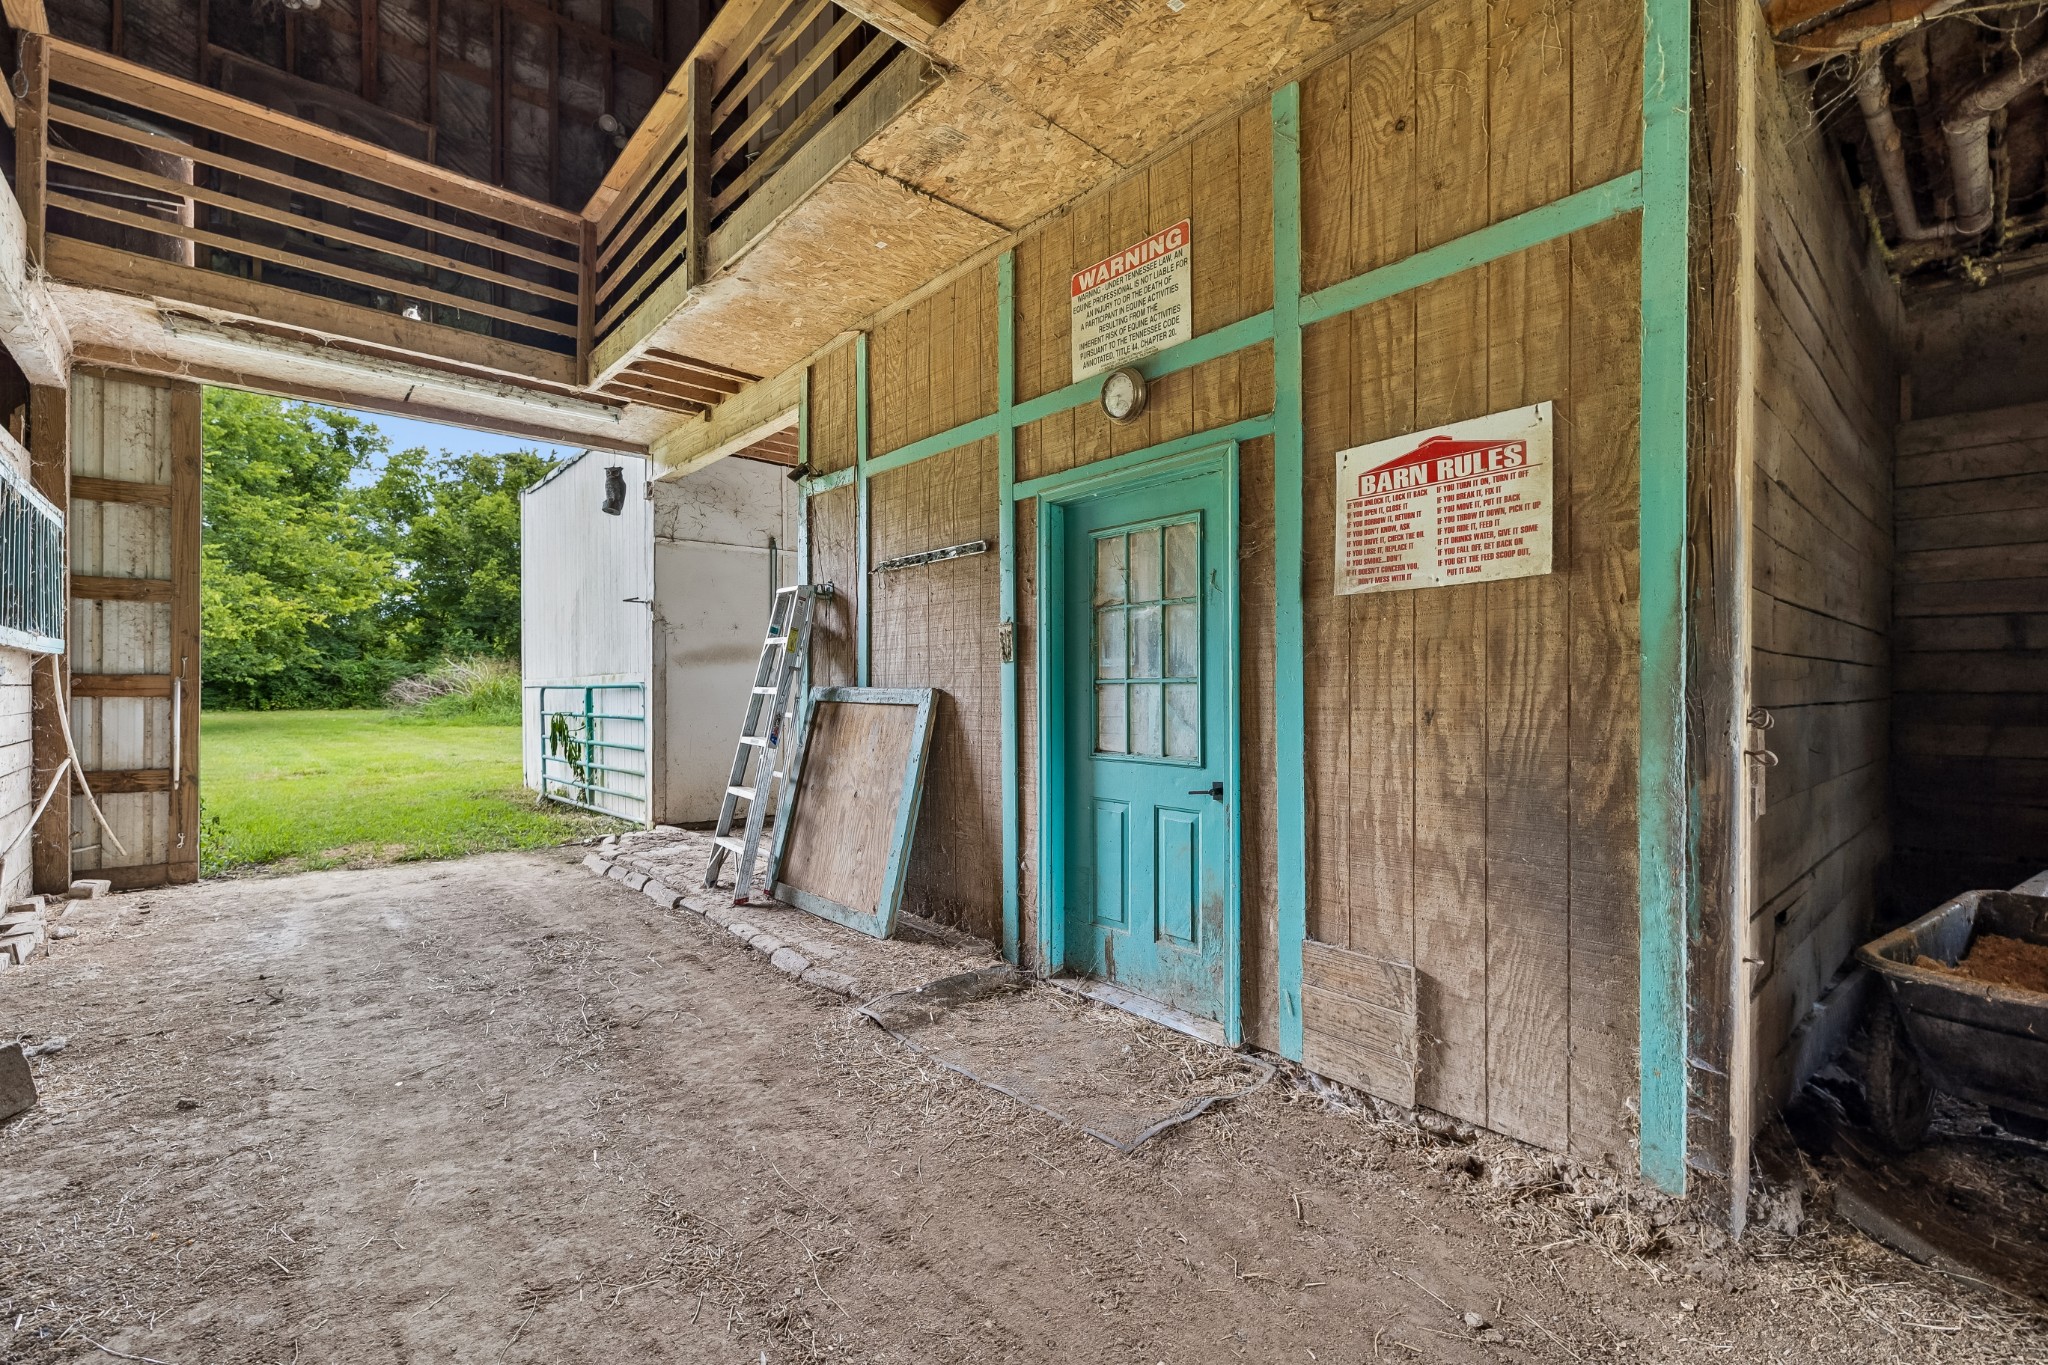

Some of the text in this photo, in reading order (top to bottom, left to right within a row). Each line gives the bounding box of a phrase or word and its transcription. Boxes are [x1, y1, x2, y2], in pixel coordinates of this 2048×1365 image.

[1078, 228, 1182, 292] WARNING
[1073, 255, 1187, 316] EQUINE PROFESSIONAL IS NOT LIABLE FOR
[1077, 286, 1100, 304] WARNING
[1105, 275, 1123, 291] UNDER
[1124, 259, 1156, 282] TENNESSEE
[1158, 252, 1172, 266] LAW,
[1174, 247, 1182, 259] AN
[1081, 281, 1178, 332] A PARTICIPANT IN EQUINE ACTIVITIES
[1086, 273, 1171, 319] AN INJURY TO OR THE DEATH OF
[1079, 302, 1180, 352] INHERENT RISK OF EQUINE ACTIVITIES
[1098, 301, 1157, 334] RESULTING FROM THE
[1080, 343, 1107, 362] PURSUANT
[1108, 339, 1115, 350] TO
[1117, 334, 1127, 347] THE
[1128, 320, 1161, 342] TENNESSEE
[1163, 313, 1179, 328] CODE
[1083, 350, 1114, 371] ANNOTATED,
[1115, 344, 1130, 358] TITLE
[1140, 329, 1166, 348] CHAPTER
[1361, 443, 1522, 496] BARN RULES
[1436, 485, 1442, 493] IF
[1443, 483, 1454, 492] YOU
[1456, 480, 1471, 489] TURN
[1492, 473, 1509, 483] TURN
[1510, 471, 1516, 479] IT
[1518, 469, 1529, 478] OFF
[1352, 501, 1363, 509] YOU
[1364, 496, 1384, 506] UNLOCK
[1392, 493, 1405, 501] LOCK
[1406, 491, 1411, 499] IT
[1413, 488, 1427, 497] BACK
[1437, 506, 1442, 514] IF
[1443, 504, 1455, 513] YOU
[1456, 501, 1472, 511] MOVE
[1483, 497, 1494, 506] PUT
[1496, 496, 1502, 504] IT
[1504, 493, 1520, 503] BACK
[1443, 494, 1454, 502] YOU
[1456, 490, 1474, 500] BREAK
[1485, 486, 1494, 495] FIX
[1495, 485, 1501, 493] IT
[1352, 510, 1362, 518] YOU
[1364, 508, 1377, 516] OPEN
[1385, 503, 1401, 512] CLOSE
[1352, 520, 1362, 528] YOU
[1364, 516, 1385, 526] BORROW
[1395, 511, 1415, 521] RETURN
[1443, 515, 1455, 523] YOU
[1456, 511, 1477, 521] THROW
[1478, 510, 1484, 518] IT
[1486, 506, 1506, 517] DOWN,
[1508, 504, 1523, 513] PICK
[1524, 502, 1530, 510] IT
[1532, 501, 1541, 509] UP
[1352, 529, 1362, 537] YOU
[1364, 527, 1378, 535] DON'T
[1380, 524, 1397, 533] KNOW,
[1399, 522, 1410, 530] ASK
[1437, 527, 1443, 535] IF
[1444, 525, 1455, 534] YOU
[1457, 523, 1468, 532] RIDE
[1479, 519, 1493, 528] FEED
[1494, 518, 1500, 526] IT
[1437, 524, 1538, 545] IF IT DRINKS WATER, GIVE IT SOME
[1352, 539, 1362, 547] YOU
[1364, 537, 1378, 545] DRIVE
[1387, 533, 1403, 542] CHECK
[1405, 531, 1415, 539] THE
[1416, 530, 1424, 538] OIL
[1444, 546, 1455, 555] YOU
[1457, 544, 1470, 553] FALL
[1484, 541, 1495, 549] GET
[1496, 538, 1512, 548] BACK
[1514, 537, 1523, 546] ON
[1352, 549, 1362, 557] YOU
[1364, 547, 1376, 555] LOSE
[1385, 543, 1407, 552] REPLACE
[1437, 558, 1443, 566] IF
[1444, 557, 1455, 565] YOU
[1457, 555, 1467, 564] GET
[1468, 554, 1479, 562] THE
[1481, 552, 1494, 561] FEED
[1495, 549, 1514, 559] SCOOP
[1358, 566, 1379, 575] DOESN'T
[1381, 563, 1405, 573] CONCERN
[1358, 572, 1411, 585] DON'T MESS WITH IT
[1466, 565, 1481, 573] BACK
